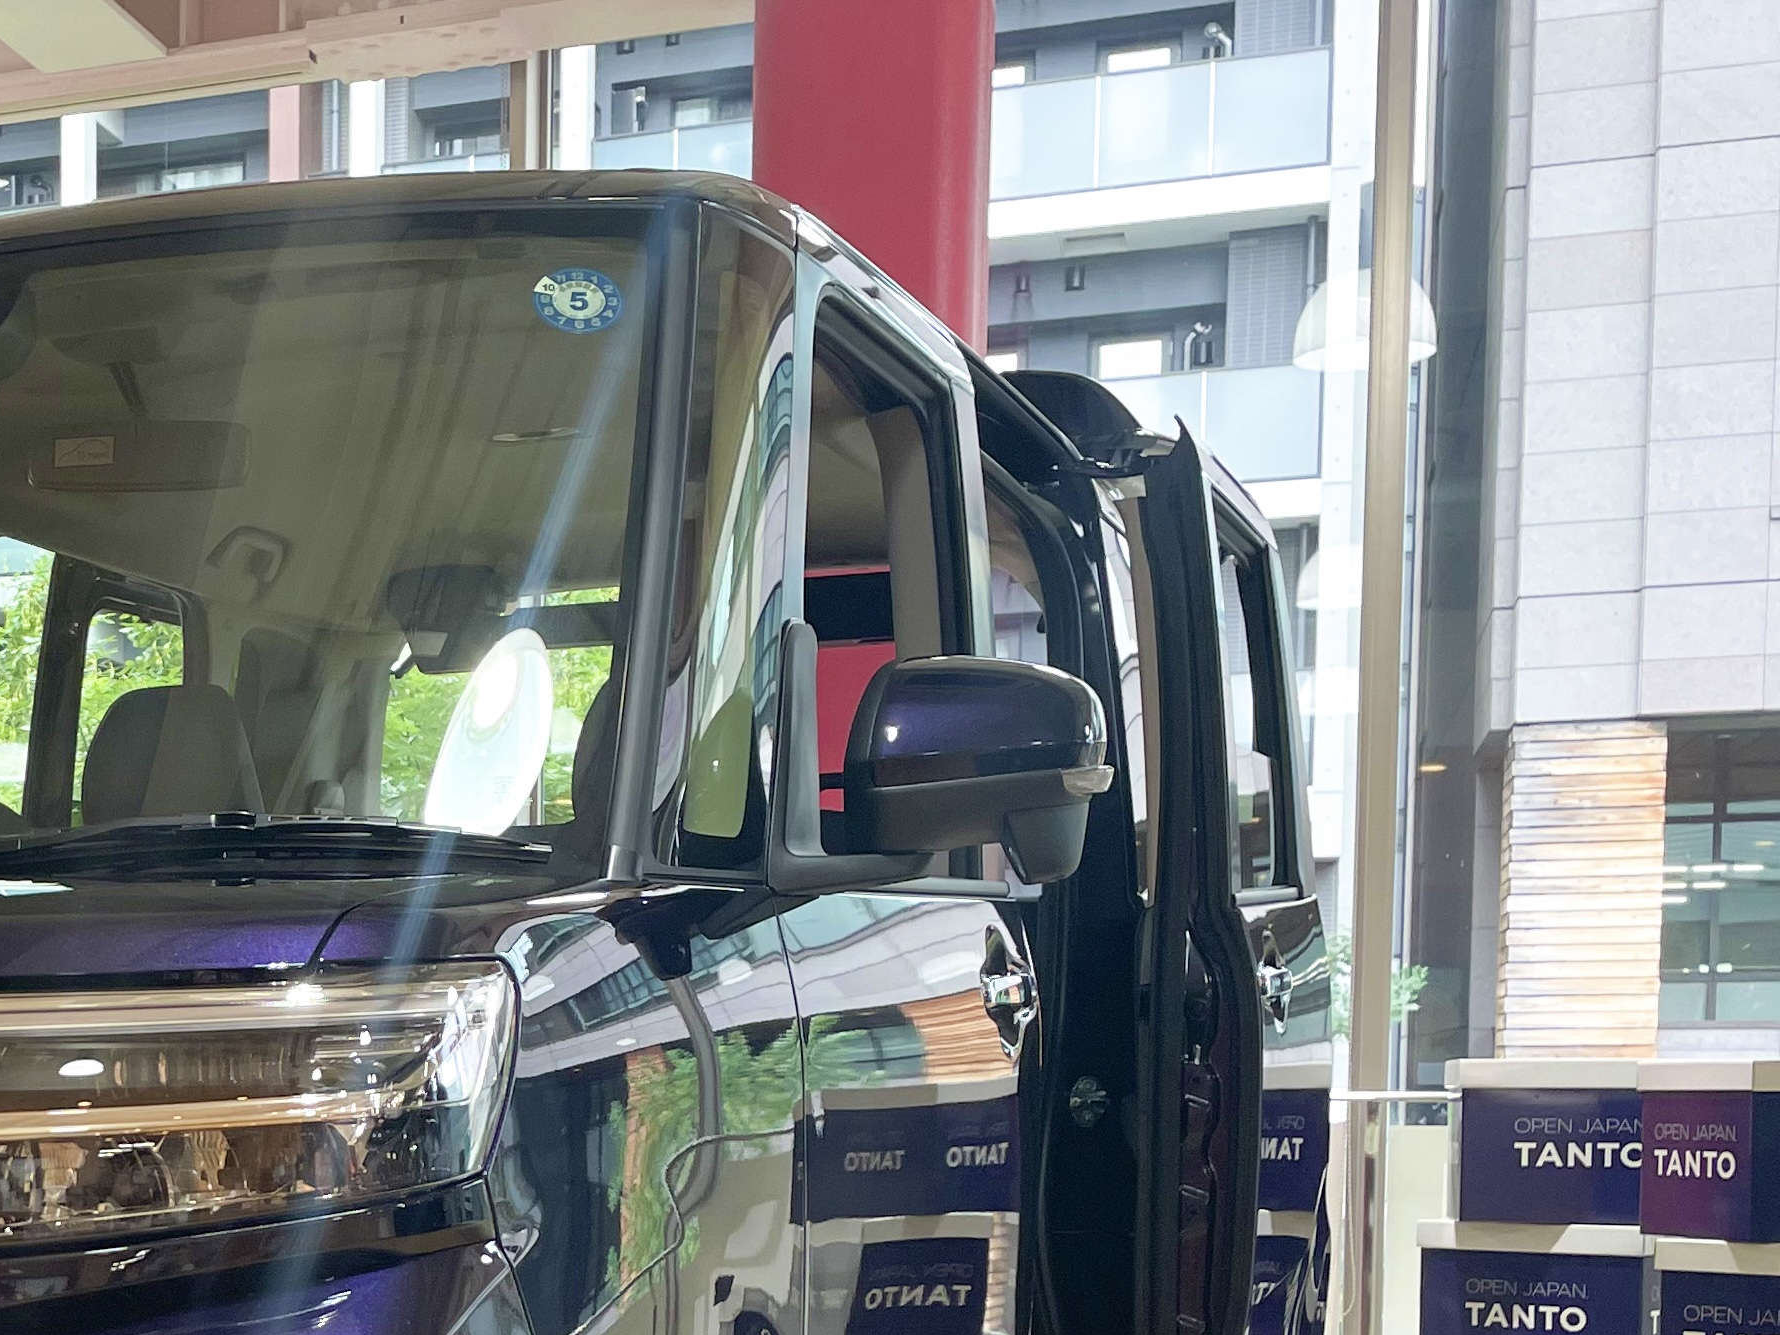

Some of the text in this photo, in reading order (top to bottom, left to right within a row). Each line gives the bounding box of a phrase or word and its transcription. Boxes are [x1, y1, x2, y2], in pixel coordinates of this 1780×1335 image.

[542, 284, 555, 292] 10
[604, 285, 614, 293] 2
[569, 291, 589, 311] 5
[557, 316, 568, 325] 7
[1514, 1117, 1572, 1134] OPEN
[1654, 1122, 1689, 1140] OPEN
[1513, 1141, 1643, 1168] TANTO
[1654, 1149, 1736, 1179] TANTO
[1465, 1278, 1517, 1296] OPEN
[1464, 1301, 1588, 1333] TANTO
[1683, 1304, 1743, 1325] OPEN
